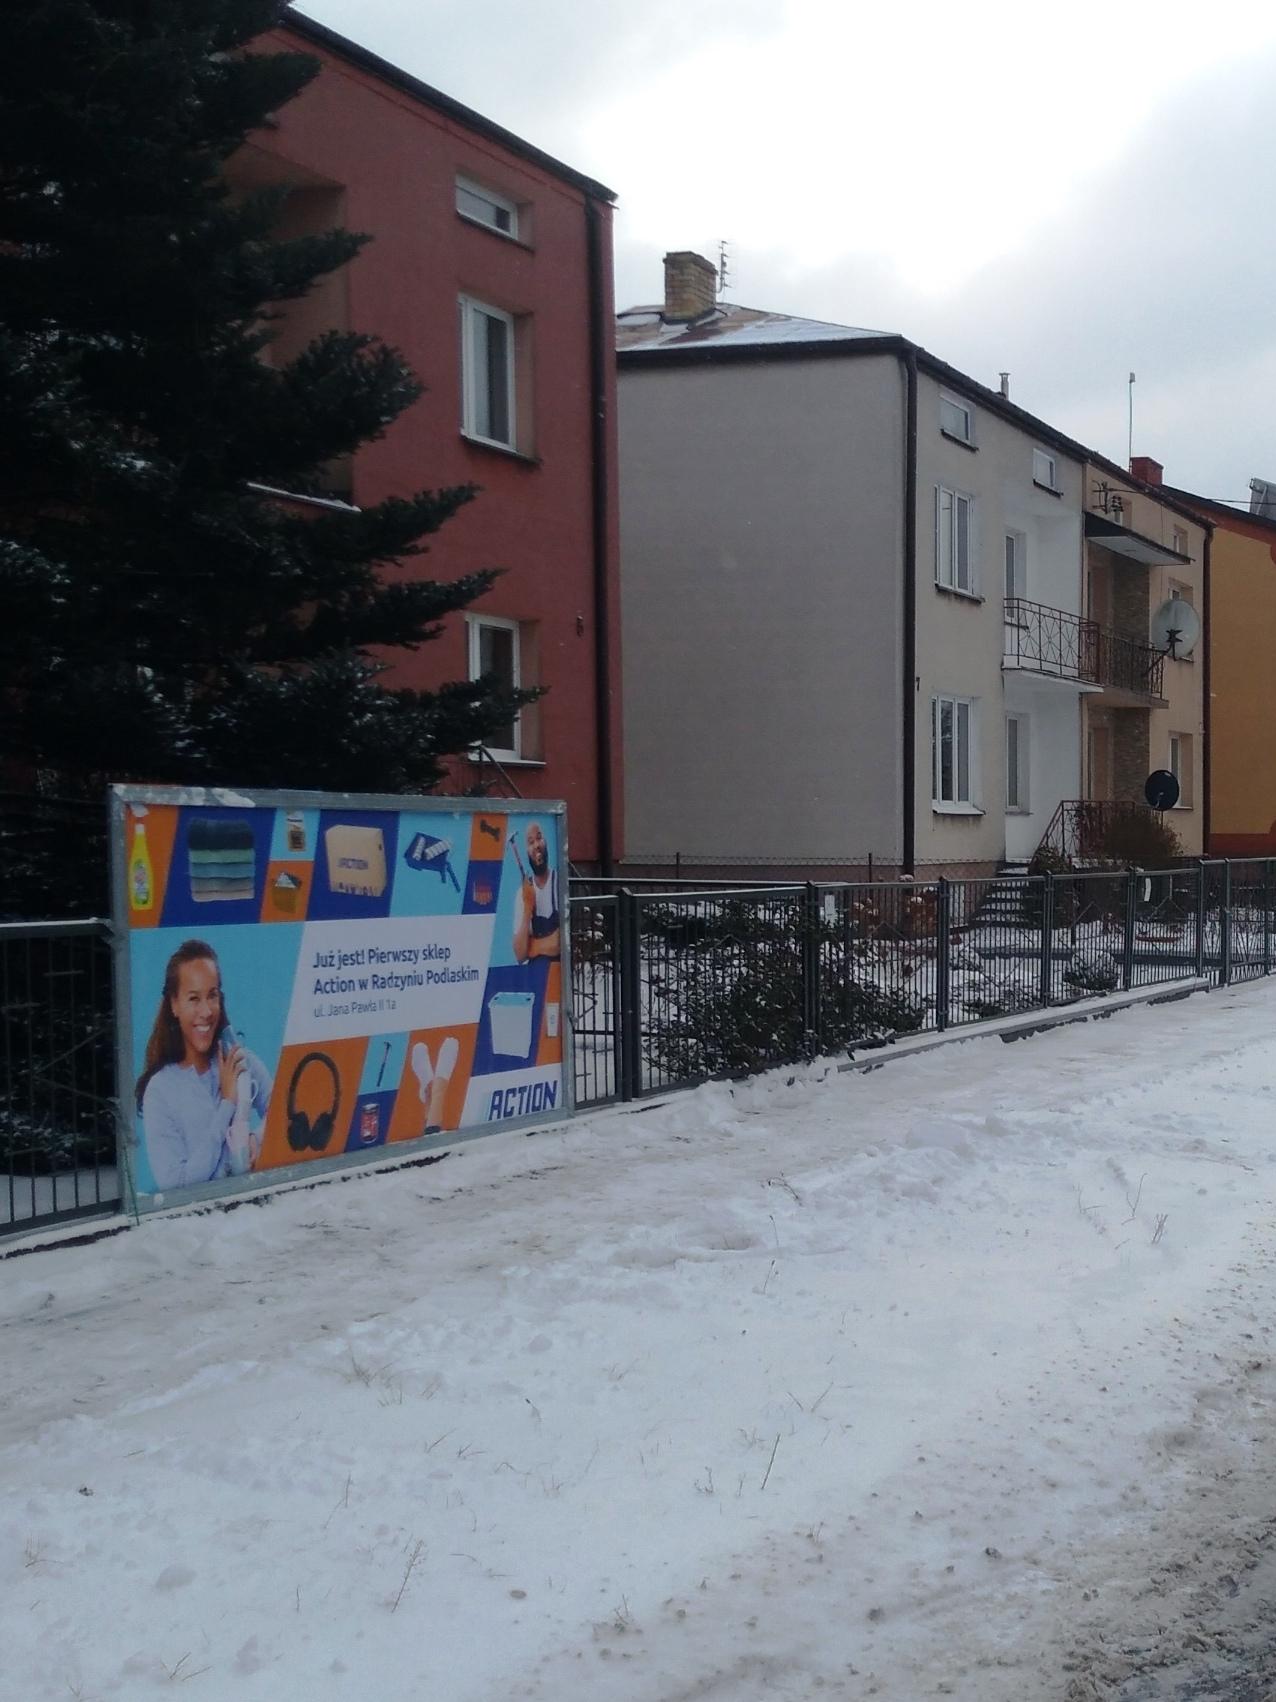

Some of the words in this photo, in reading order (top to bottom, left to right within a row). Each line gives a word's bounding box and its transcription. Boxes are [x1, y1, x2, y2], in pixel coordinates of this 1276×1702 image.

[313, 950, 335, 968] Już
[337, 949, 365, 970] jest!
[368, 947, 419, 965] Pierwszy
[422, 943, 451, 962] sklep
[314, 976, 356, 995] Action
[358, 979, 368, 991] w
[372, 971, 423, 991] Radzyniu
[426, 965, 479, 984] Podlaskim
[328, 1004, 350, 1016] Jana
[488, 1080, 558, 1121] ACTION
